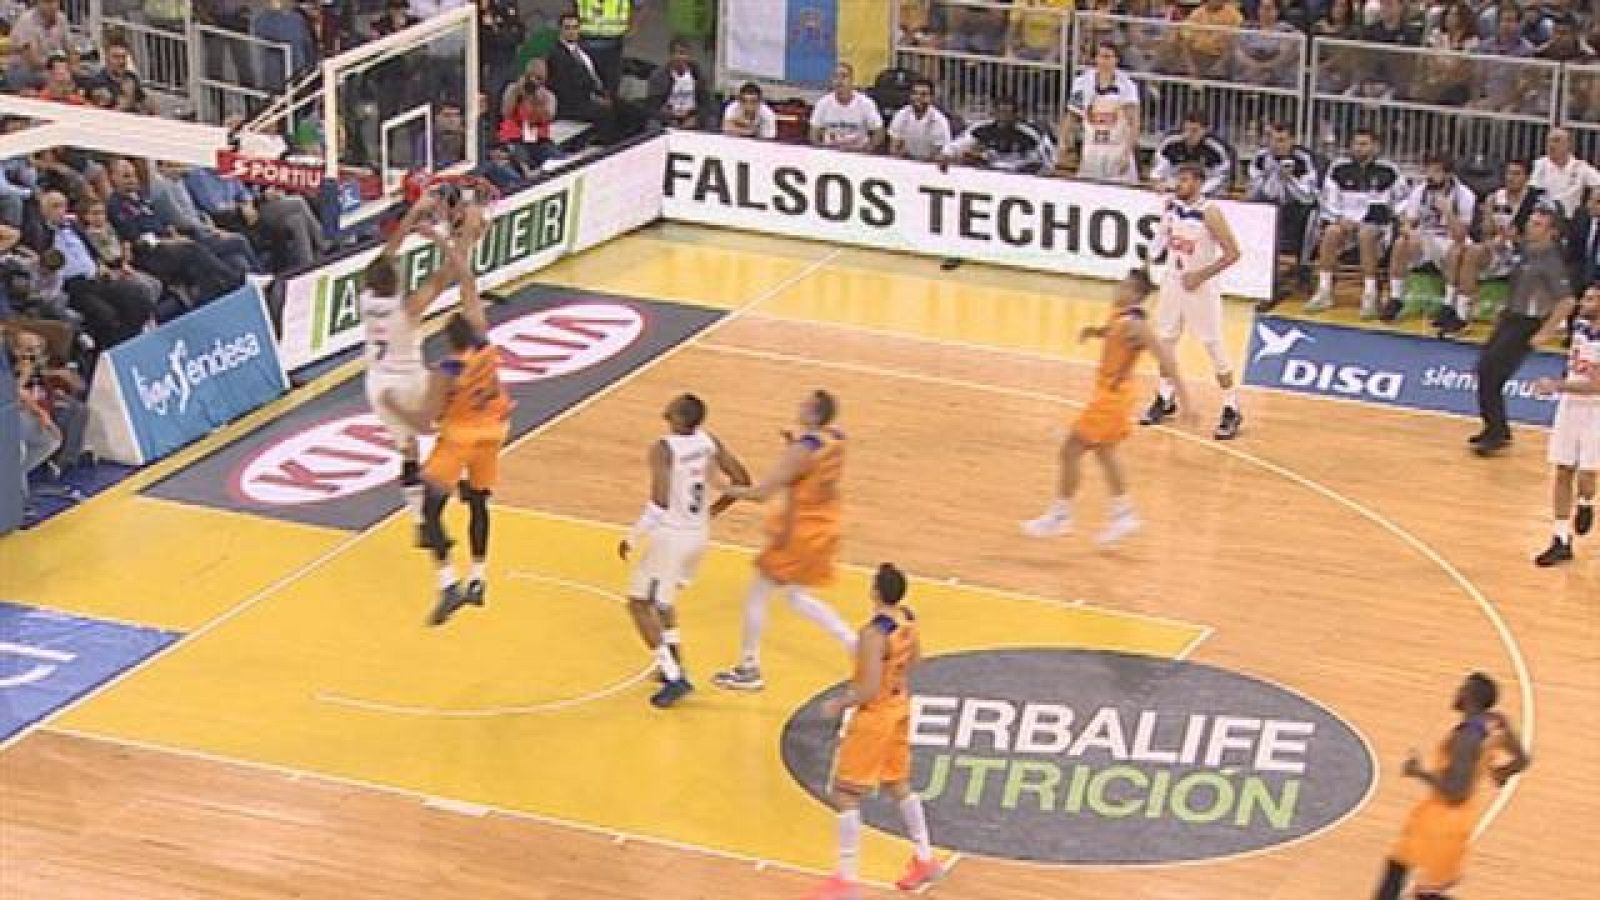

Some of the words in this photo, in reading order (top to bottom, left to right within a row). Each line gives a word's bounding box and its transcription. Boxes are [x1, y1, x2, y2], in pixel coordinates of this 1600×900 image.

[662, 151, 896, 228] FALSOS
[918, 184, 1168, 266] TECHOS
[495, 314, 636, 375] KIA
[838, 695, 1314, 773] ERBALIFE
[826, 754, 1302, 829] UTRICIÓN
